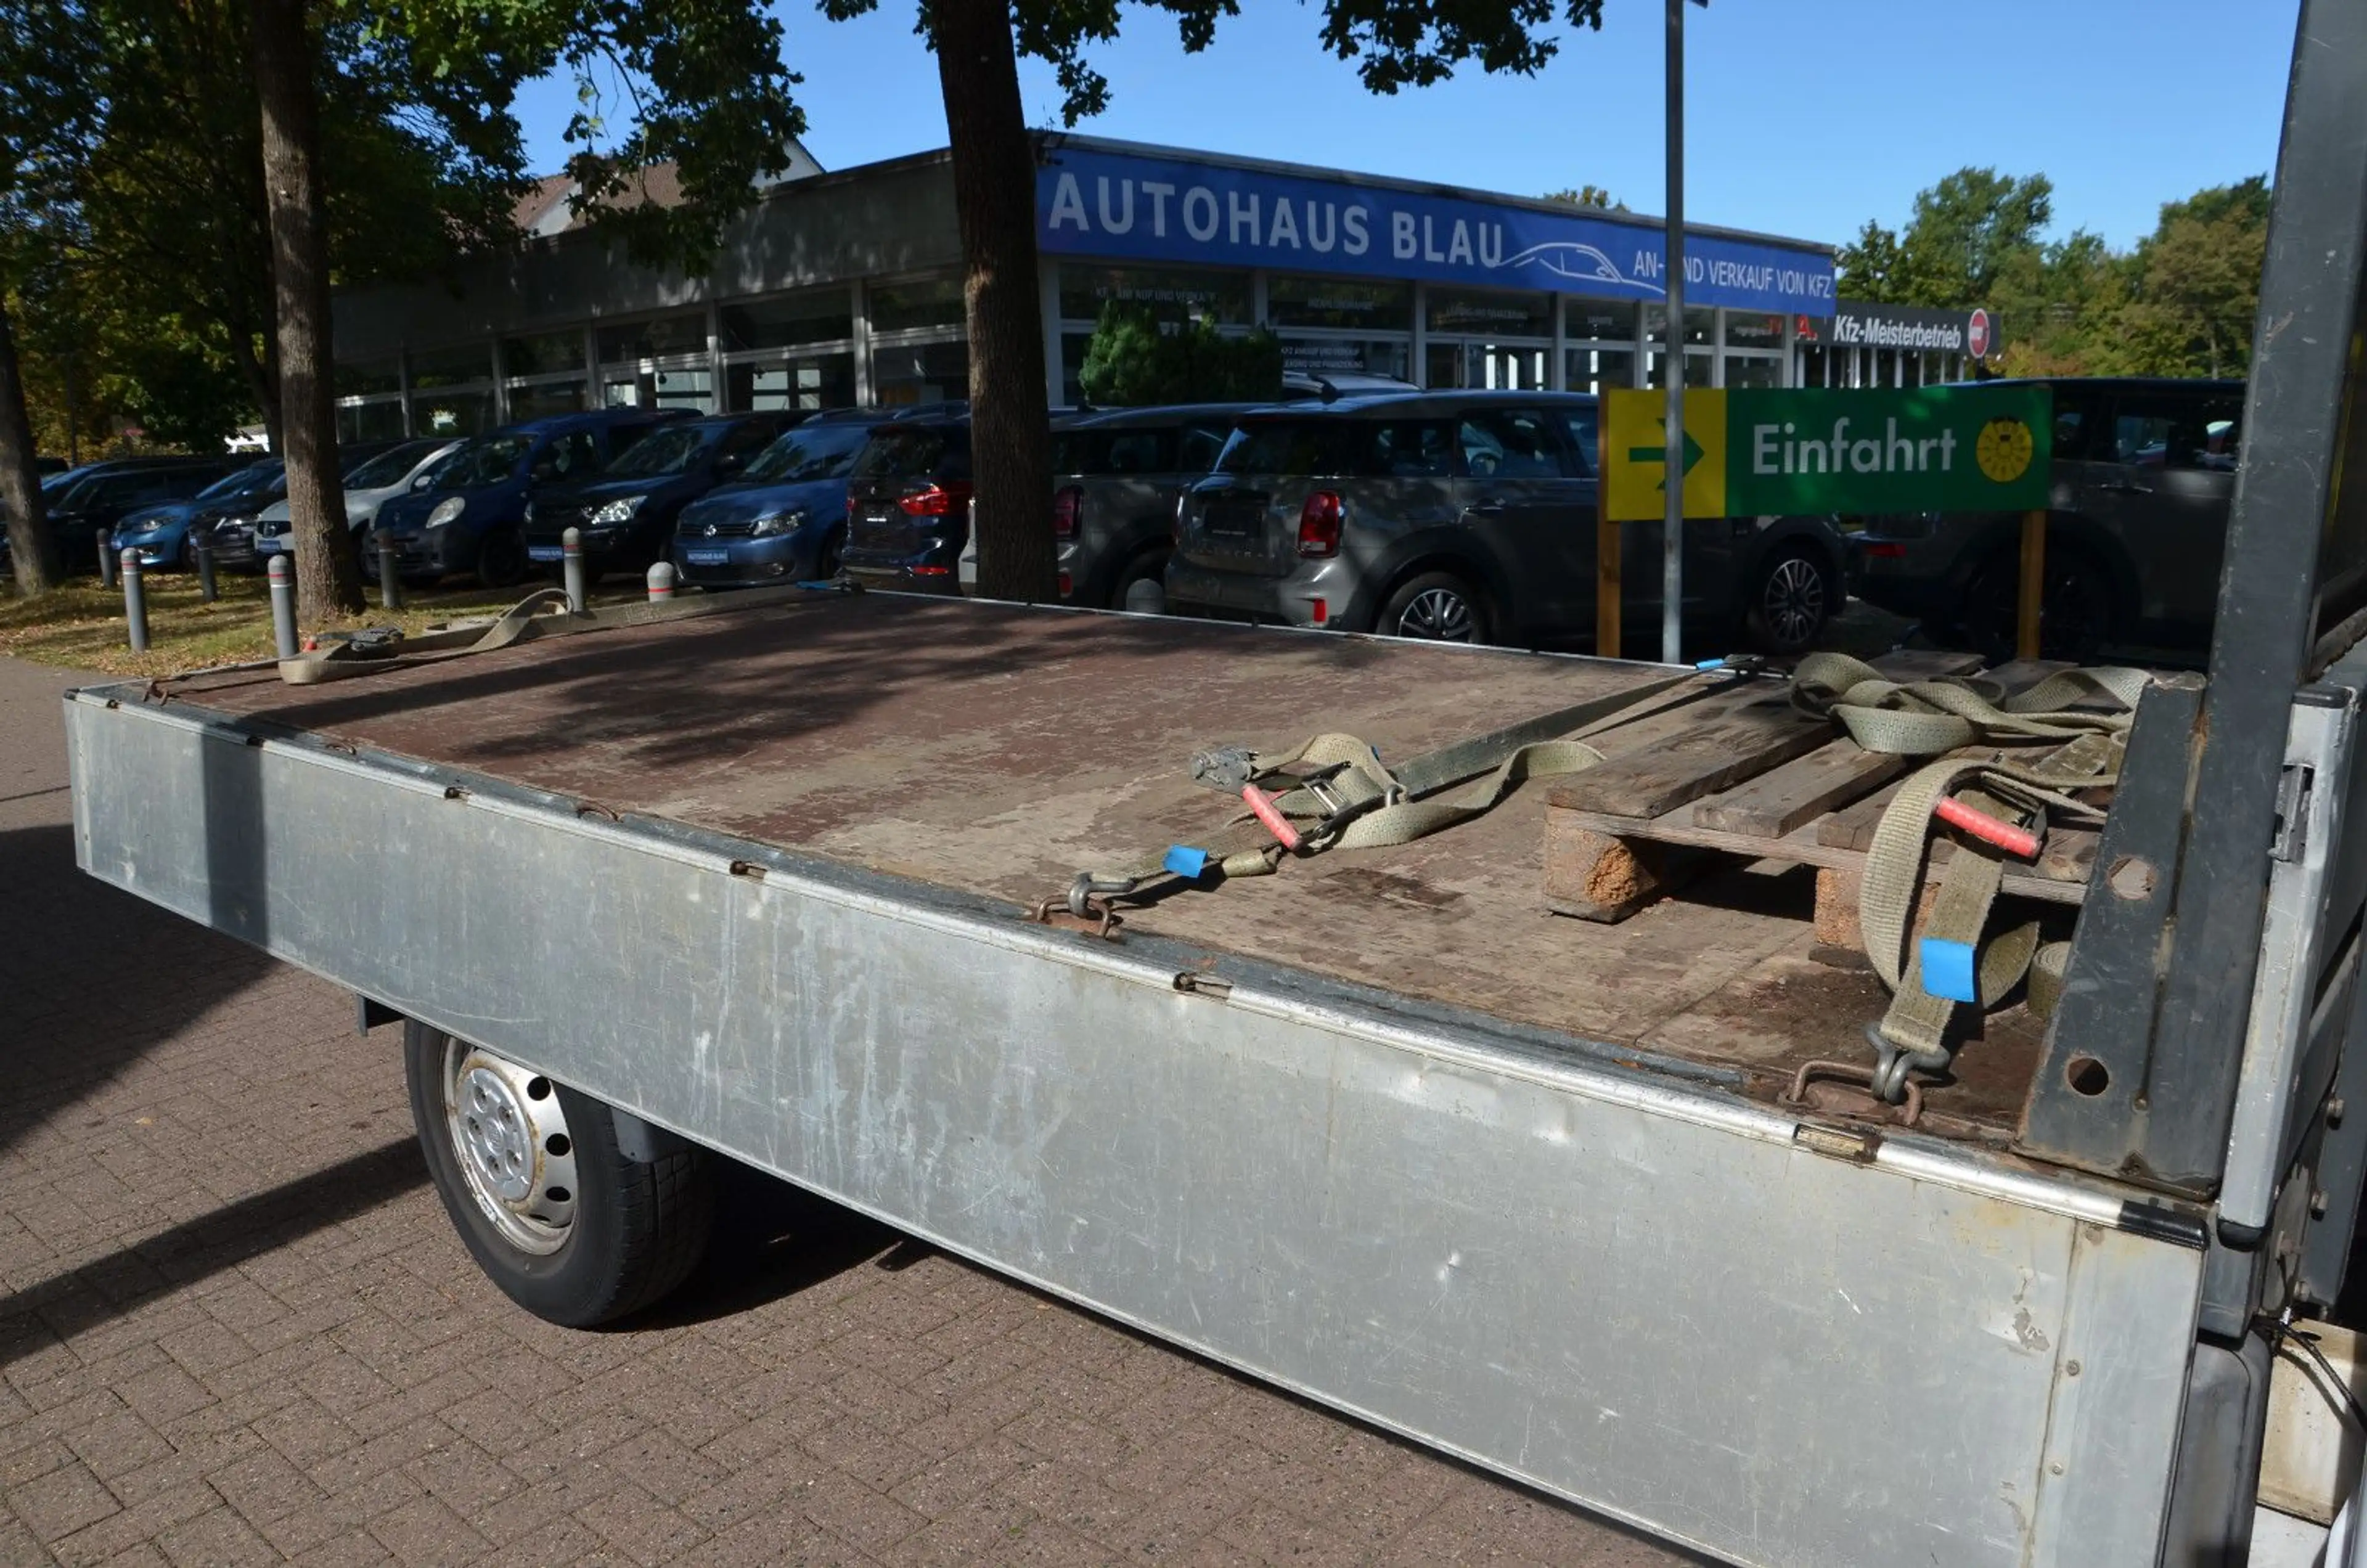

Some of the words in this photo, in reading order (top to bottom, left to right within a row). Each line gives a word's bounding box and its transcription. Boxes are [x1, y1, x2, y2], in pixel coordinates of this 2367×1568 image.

[1049, 173, 1370, 255] AUTOHAUS
[1392, 211, 1503, 269] BLAU
[1633, 250, 1666, 278] AN-
[1709, 260, 1773, 291] VERKAUF
[1776, 269, 1805, 296] VON
[1809, 274, 1833, 298] KFZ
[1833, 315, 1961, 349] Kfz-Meisterbetrieb
[1753, 417, 1956, 475] Einfahrt
